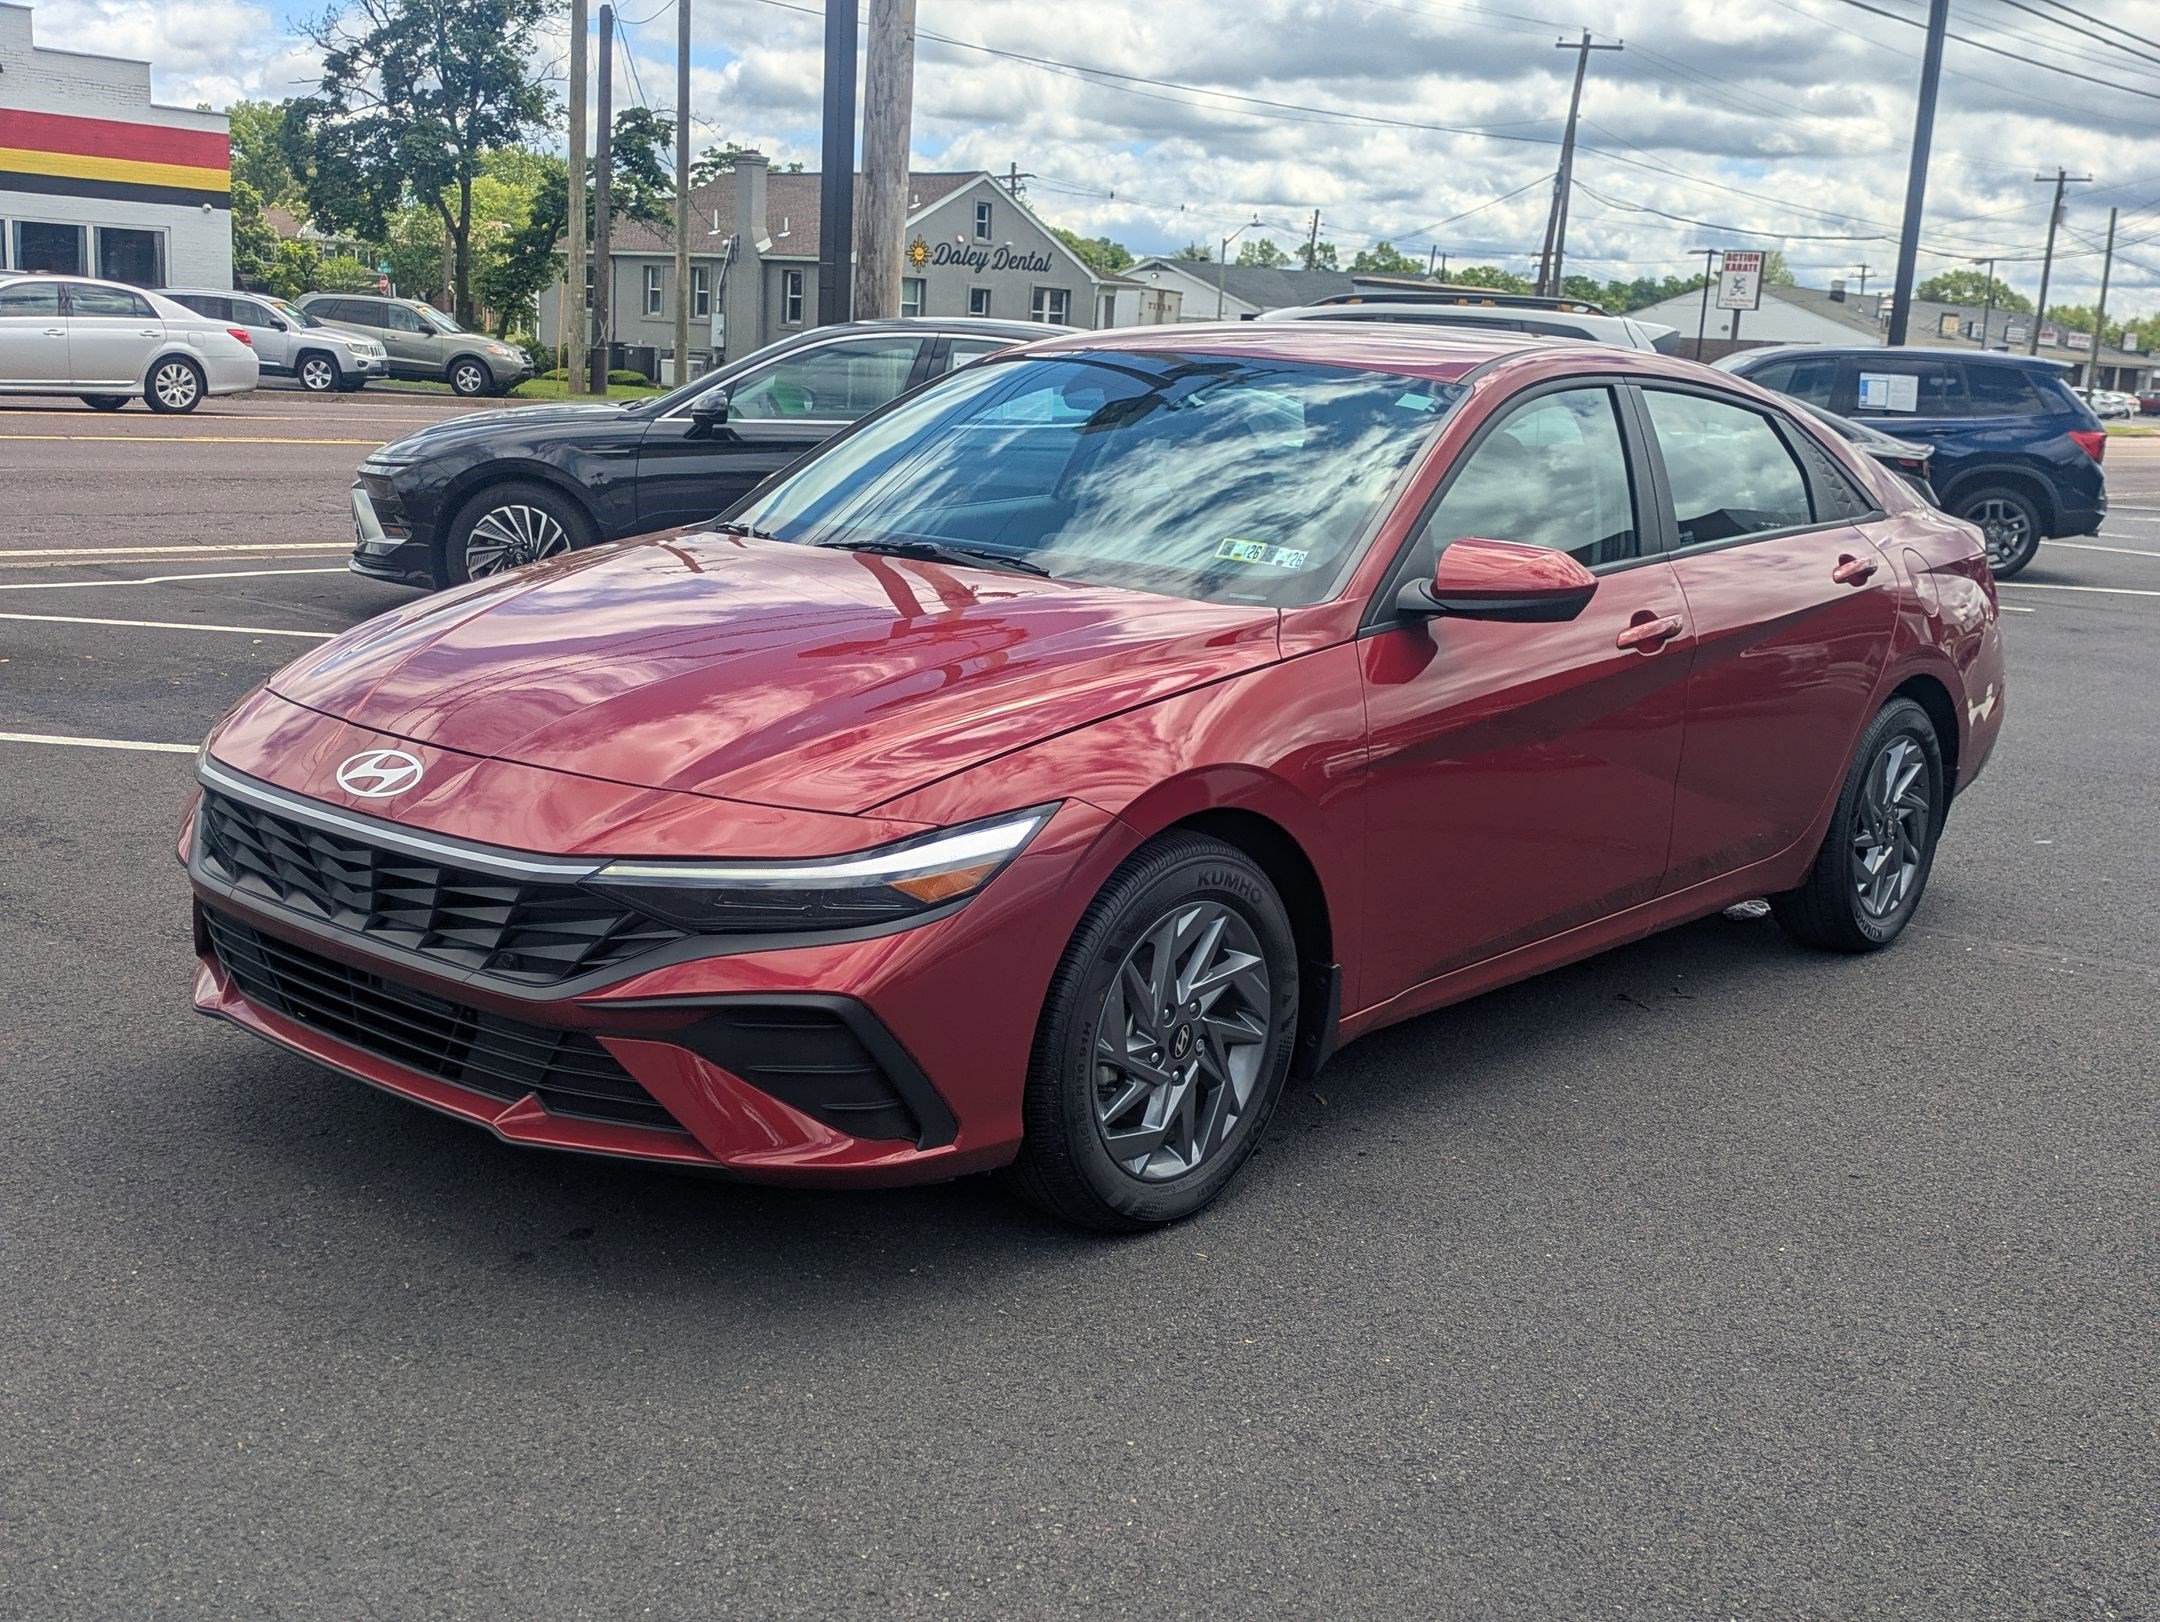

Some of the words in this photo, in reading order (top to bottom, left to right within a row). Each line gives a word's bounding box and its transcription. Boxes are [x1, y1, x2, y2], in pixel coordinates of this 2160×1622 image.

[932, 242, 990, 273] Daley
[991, 247, 1053, 272] Dental
[1724, 263, 1758, 272] KARATE
[1726, 252, 1760, 262] ACTION
[1197, 869, 1263, 903] KUMHO
[1855, 909, 1883, 939] KUMHO
